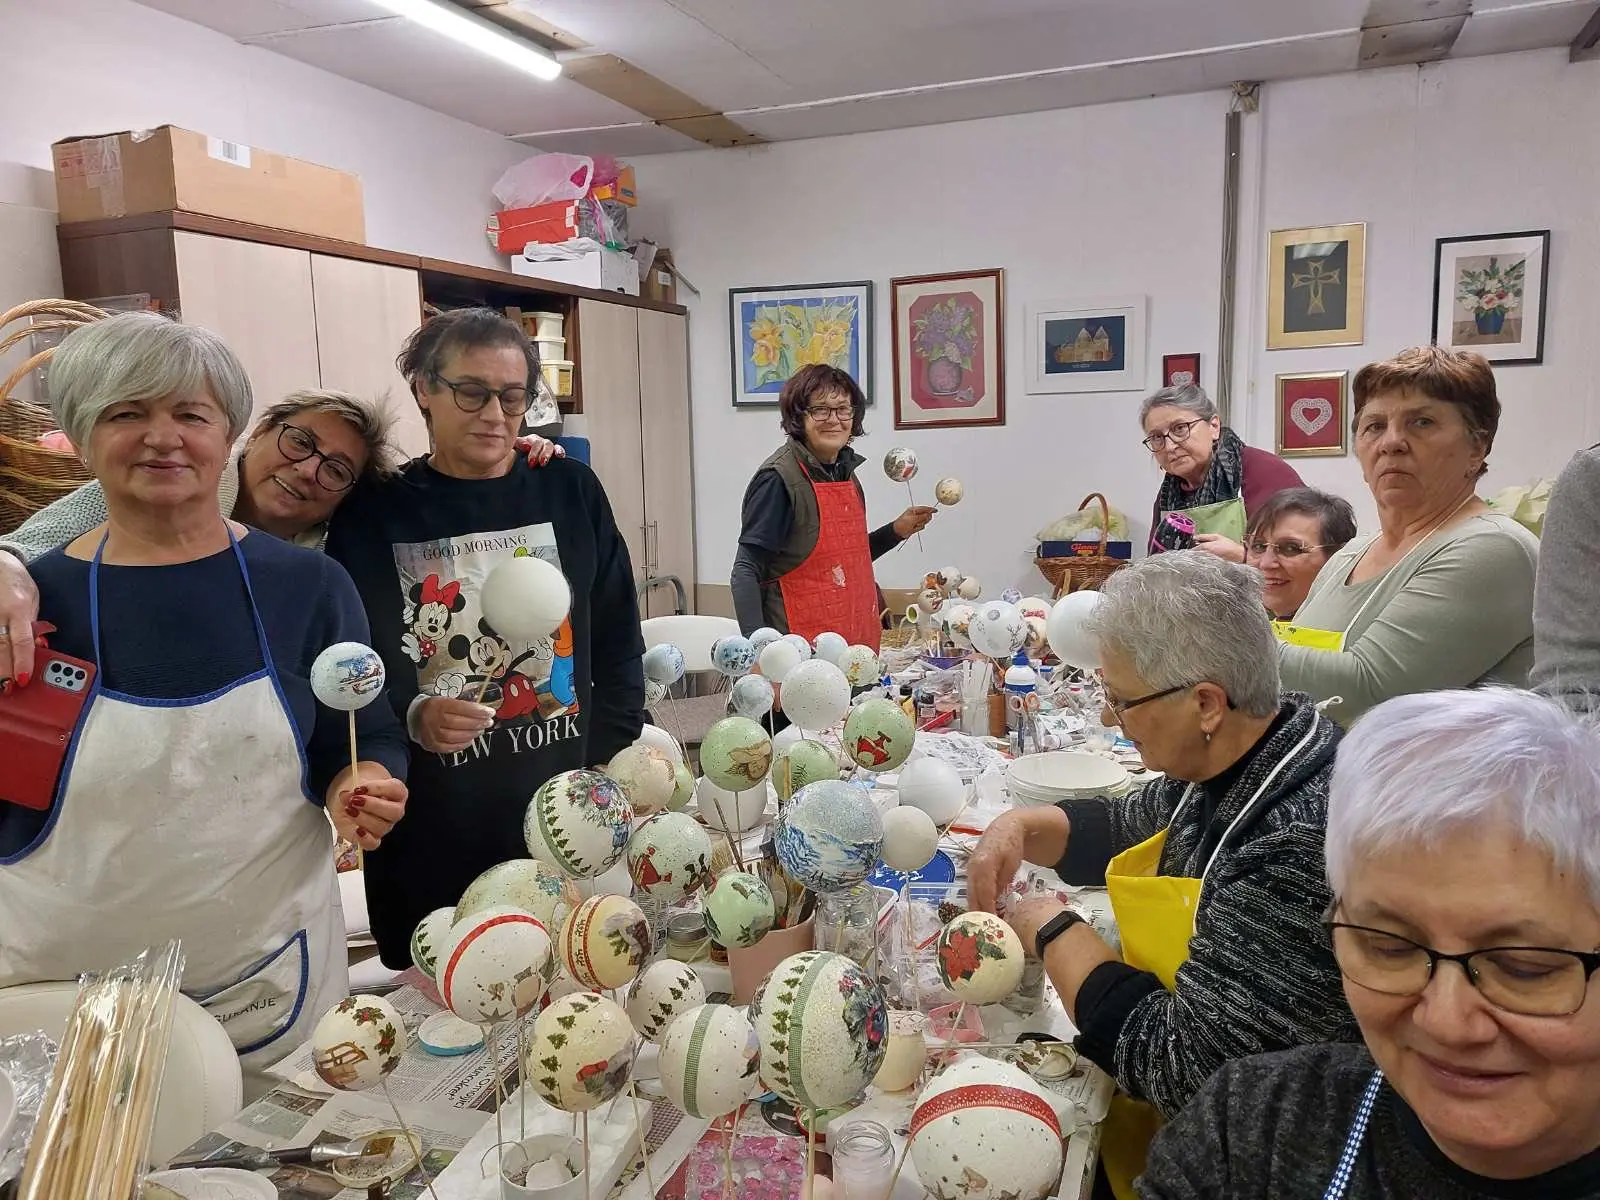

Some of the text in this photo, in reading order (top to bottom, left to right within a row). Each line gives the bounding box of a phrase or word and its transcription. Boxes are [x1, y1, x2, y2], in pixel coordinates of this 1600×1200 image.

[423, 534, 527, 561] GOOD MORNING
[437, 713, 582, 768] EW YORK
